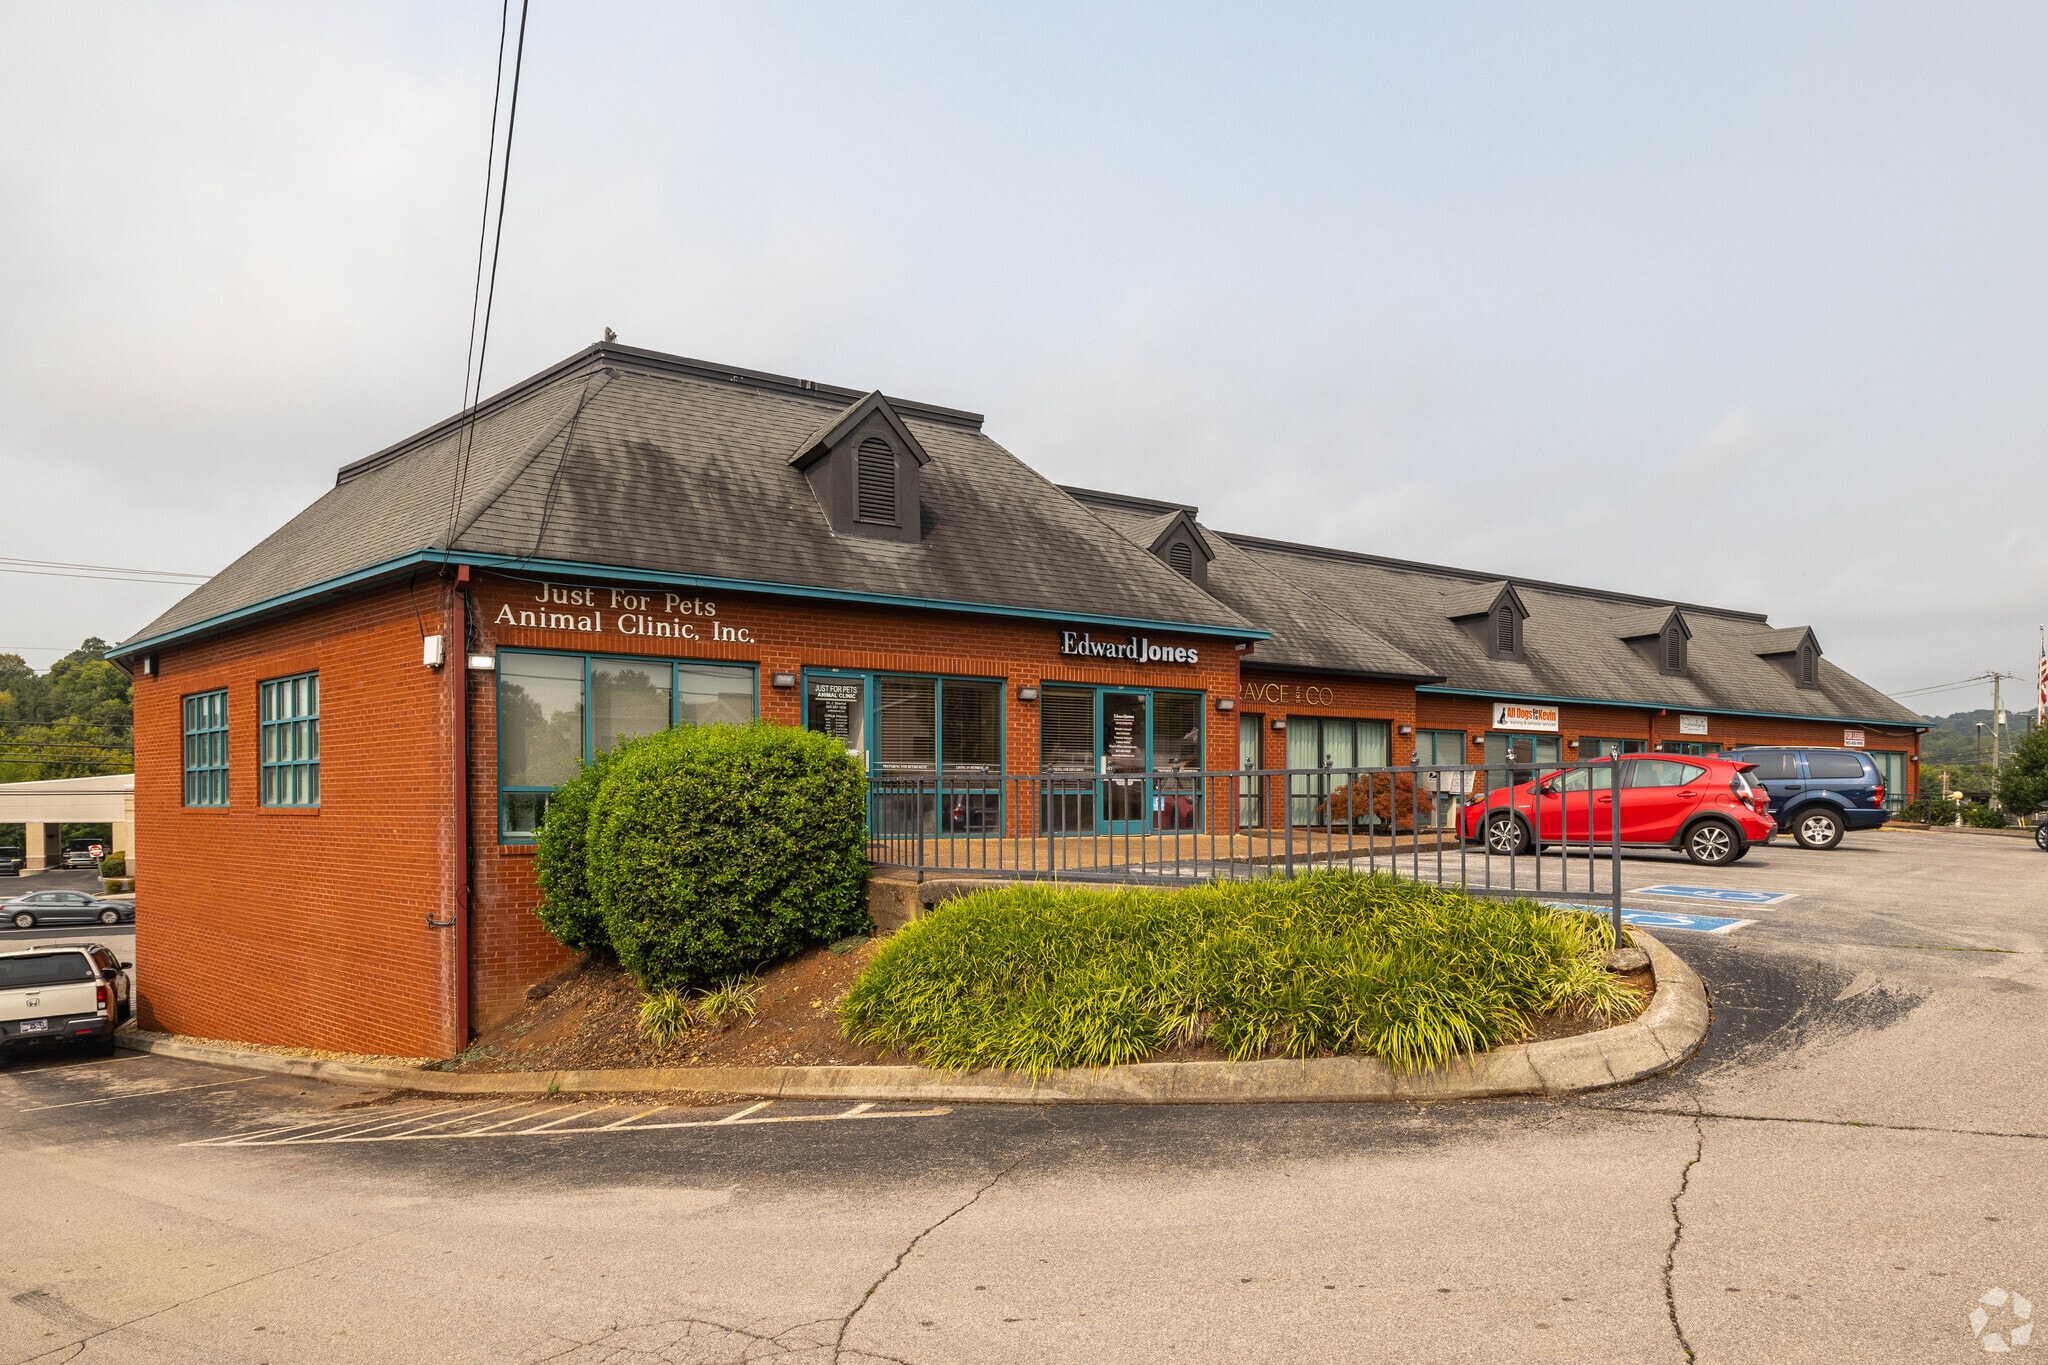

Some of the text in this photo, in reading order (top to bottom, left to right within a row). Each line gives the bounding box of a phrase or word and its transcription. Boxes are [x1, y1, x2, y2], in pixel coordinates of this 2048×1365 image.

[535, 582, 717, 617] Just For Pets
[494, 603, 756, 644] Animal Clinic, Inc.
[829, 685, 842, 693] FOR
[1306, 686, 1333, 706] CO
[1508, 707, 1532, 720] All Dogs
[1538, 709, 1556, 721] Kevin
